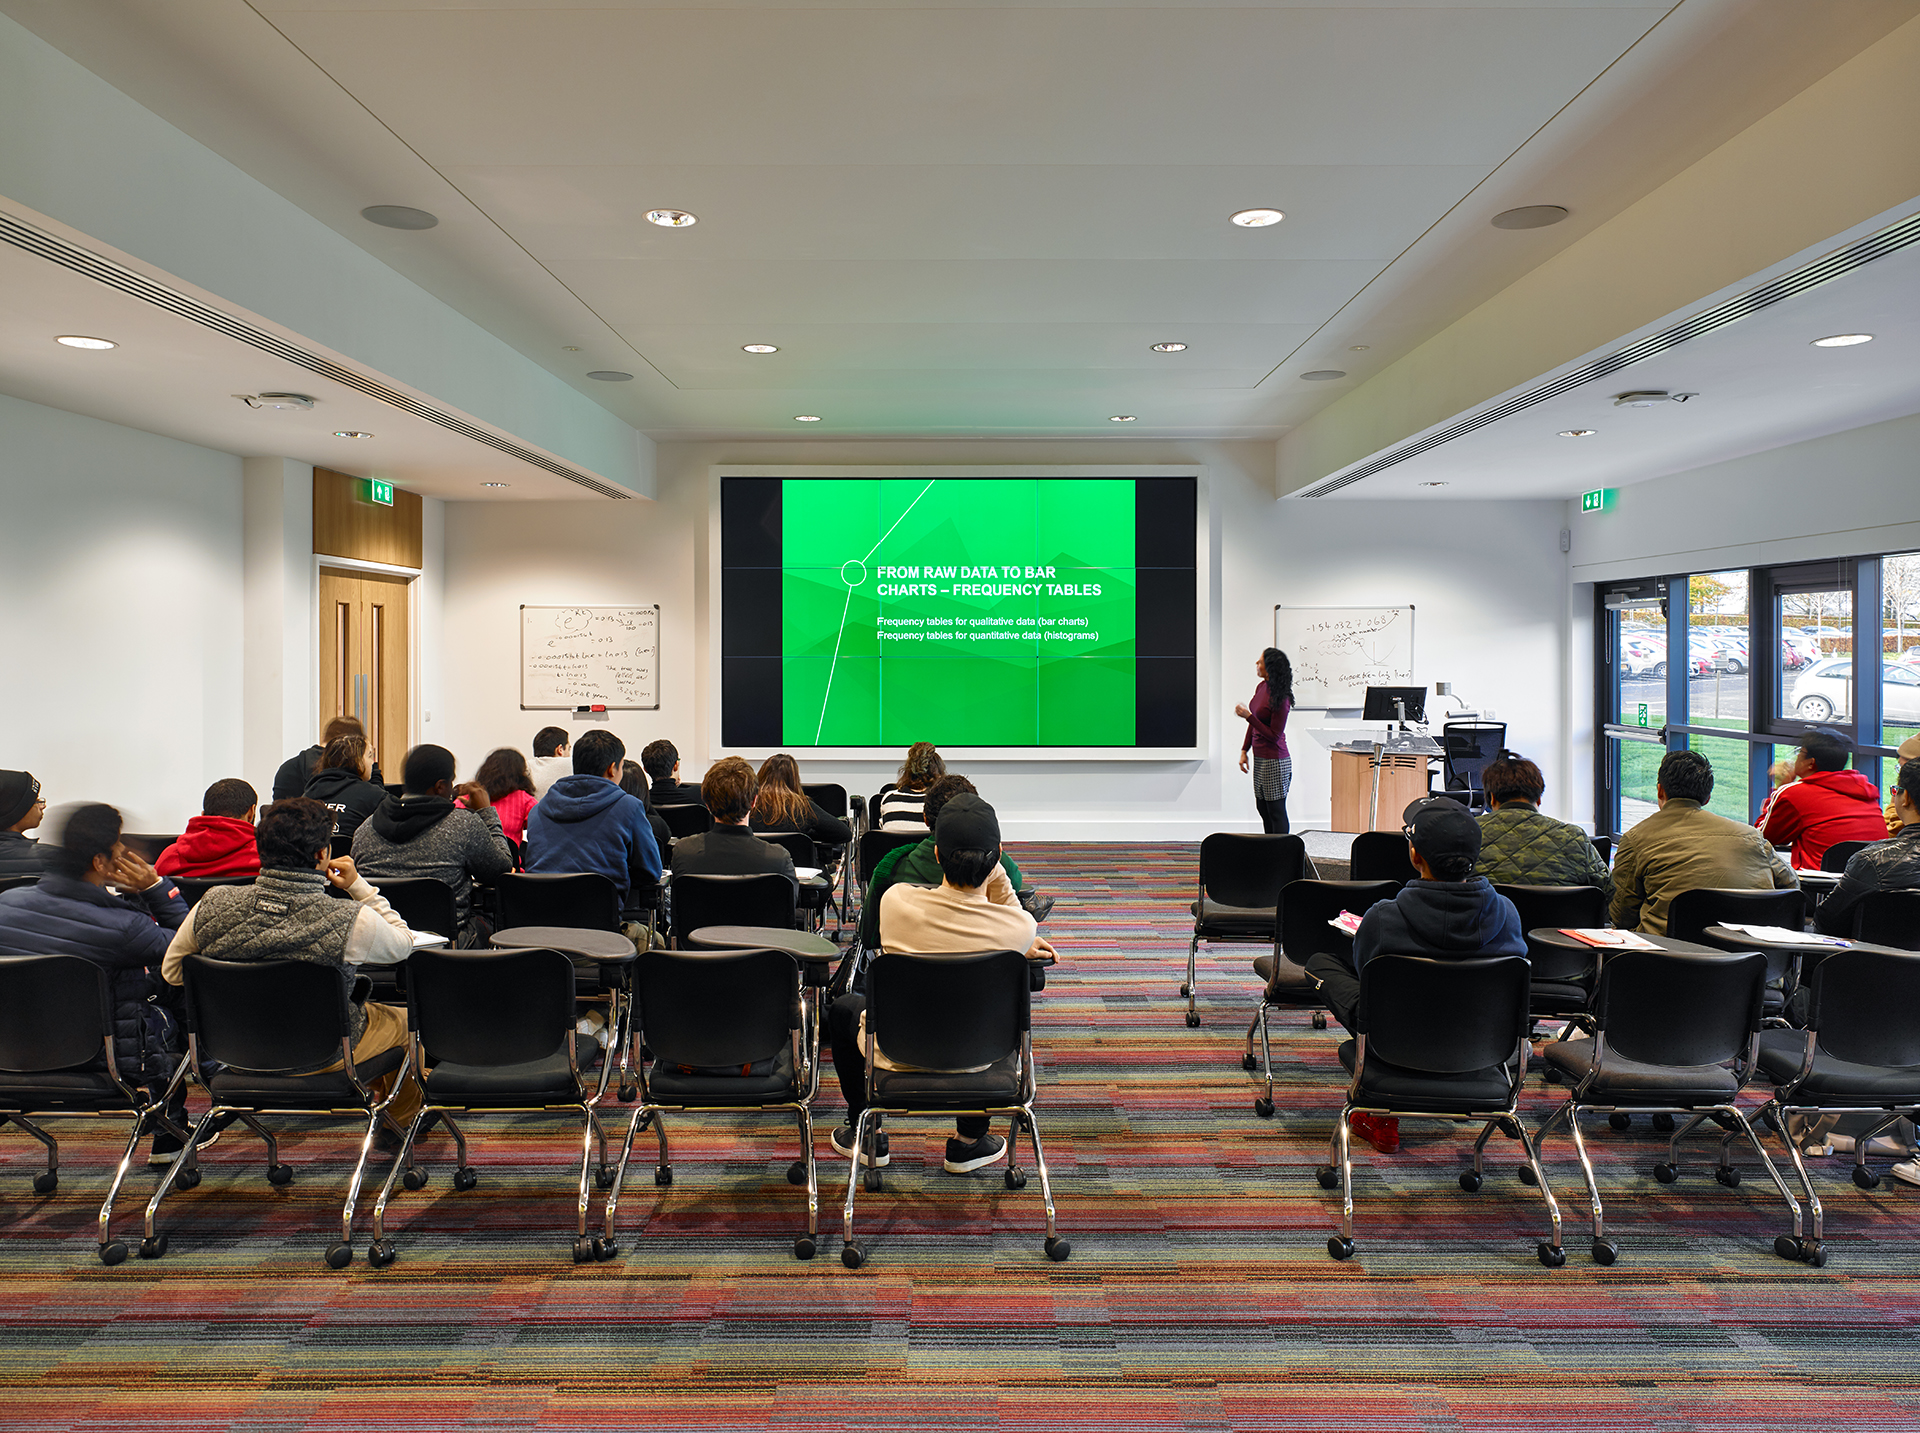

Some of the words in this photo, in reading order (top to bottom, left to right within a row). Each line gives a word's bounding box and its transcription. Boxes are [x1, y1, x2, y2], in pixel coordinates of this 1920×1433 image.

[877, 566, 920, 579] FROM
[923, 566, 957, 579] RAW
[960, 566, 999, 579] DATA
[1001, 566, 1021, 579] TO
[1024, 566, 1056, 579] BAR
[877, 584, 937, 596] CHARTS
[952, 584, 1042, 597] FREQUENCY
[1046, 584, 1102, 596] TABLES
[877, 617, 924, 627] Frequency
[926, 617, 953, 626] tables
[955, 617, 967, 626] for
[969, 617, 1014, 627] qualitative
[1016, 617, 1035, 626] data
[1038, 617, 1056, 627] (bar
[1058, 617, 1089, 627] charts)
[877, 631, 924, 641] Frequency
[926, 631, 953, 640] tables
[955, 631, 967, 640] for
[969, 631, 1020, 641] quantitative
[1022, 631, 1041, 640] data
[1044, 631, 1099, 641] (histograms)
